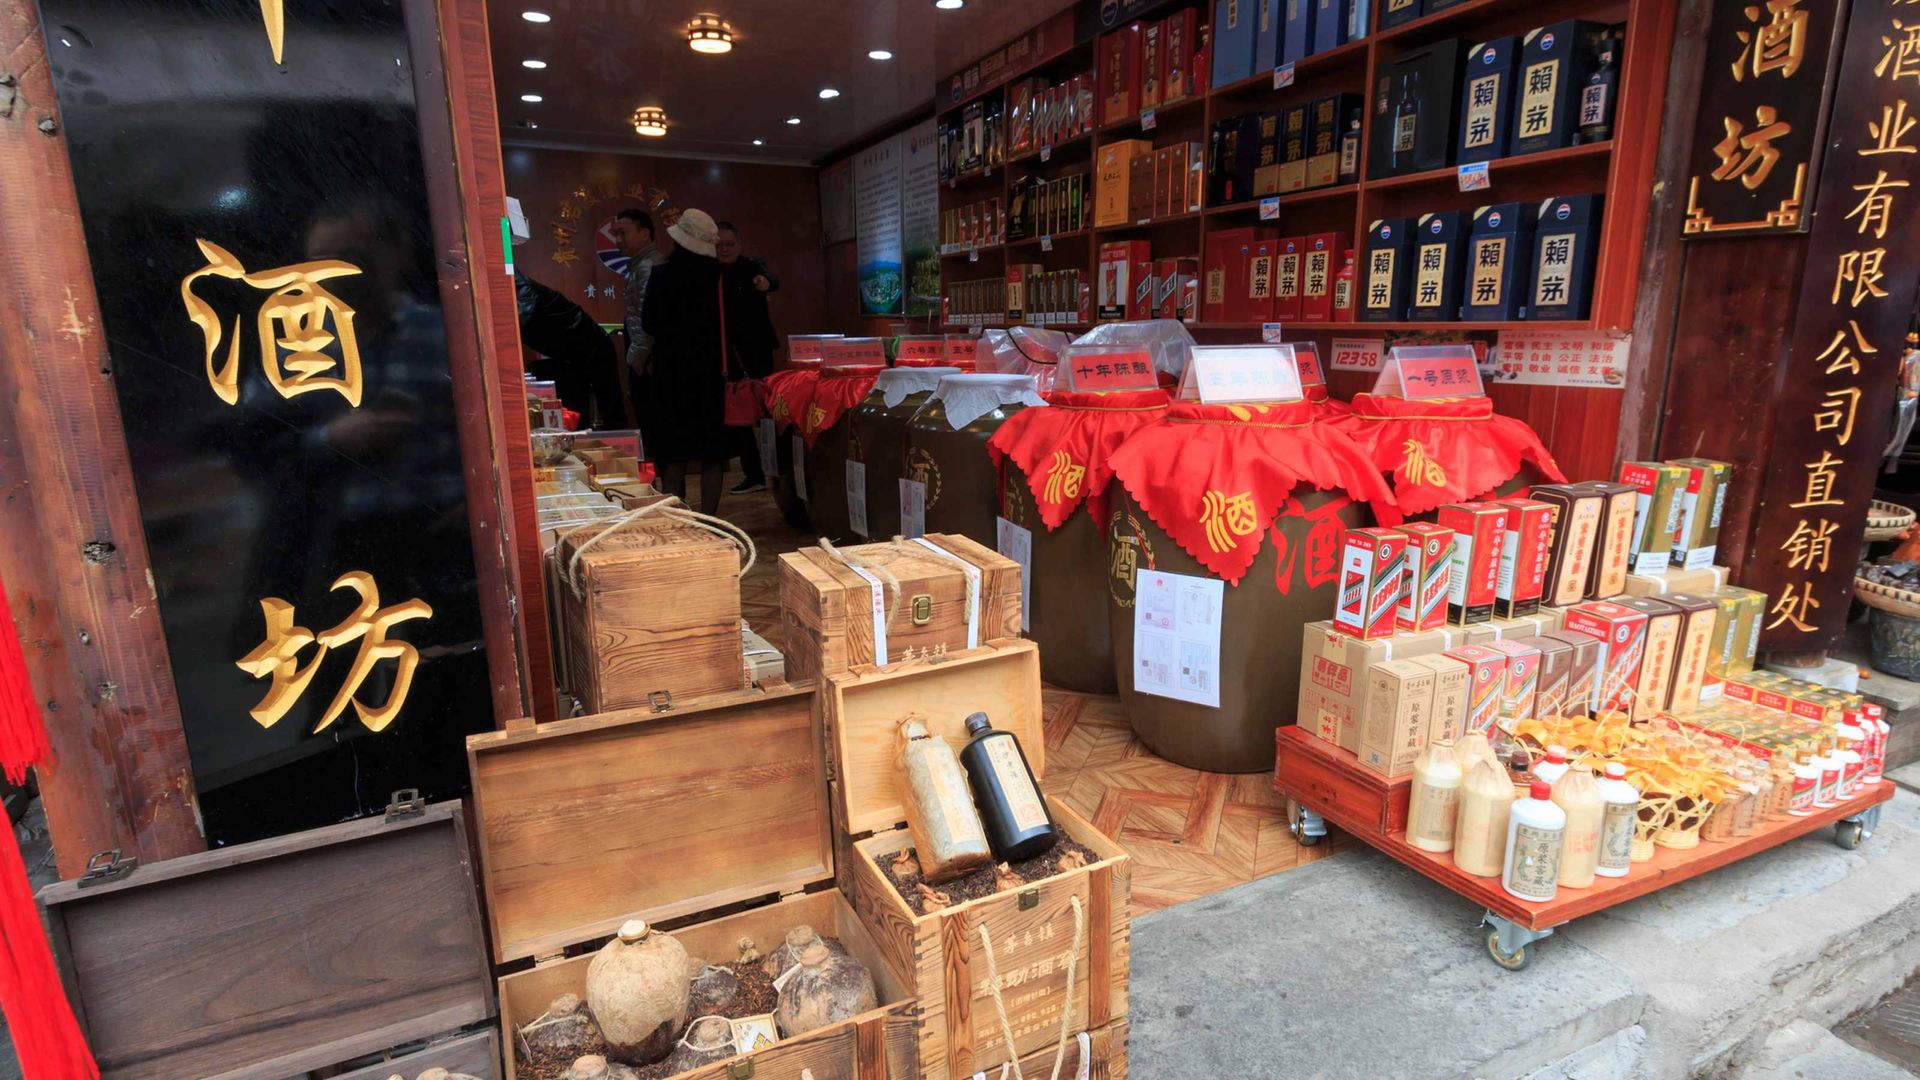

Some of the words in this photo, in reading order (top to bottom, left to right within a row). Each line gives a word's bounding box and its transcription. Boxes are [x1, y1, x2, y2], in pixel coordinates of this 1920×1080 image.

[1711, 0, 1809, 189] 酒坊
[1372, 253, 1390, 304] 賴茅
[1421, 247, 1441, 303] 賴茅
[1477, 242, 1500, 302] 賴茅
[1542, 238, 1568, 302] 賴茅
[1766, 0, 1920, 631] 酒业有限公司直销处
[180, 0, 433, 734] 酒坊
[1335, 351, 1377, 367] 12358
